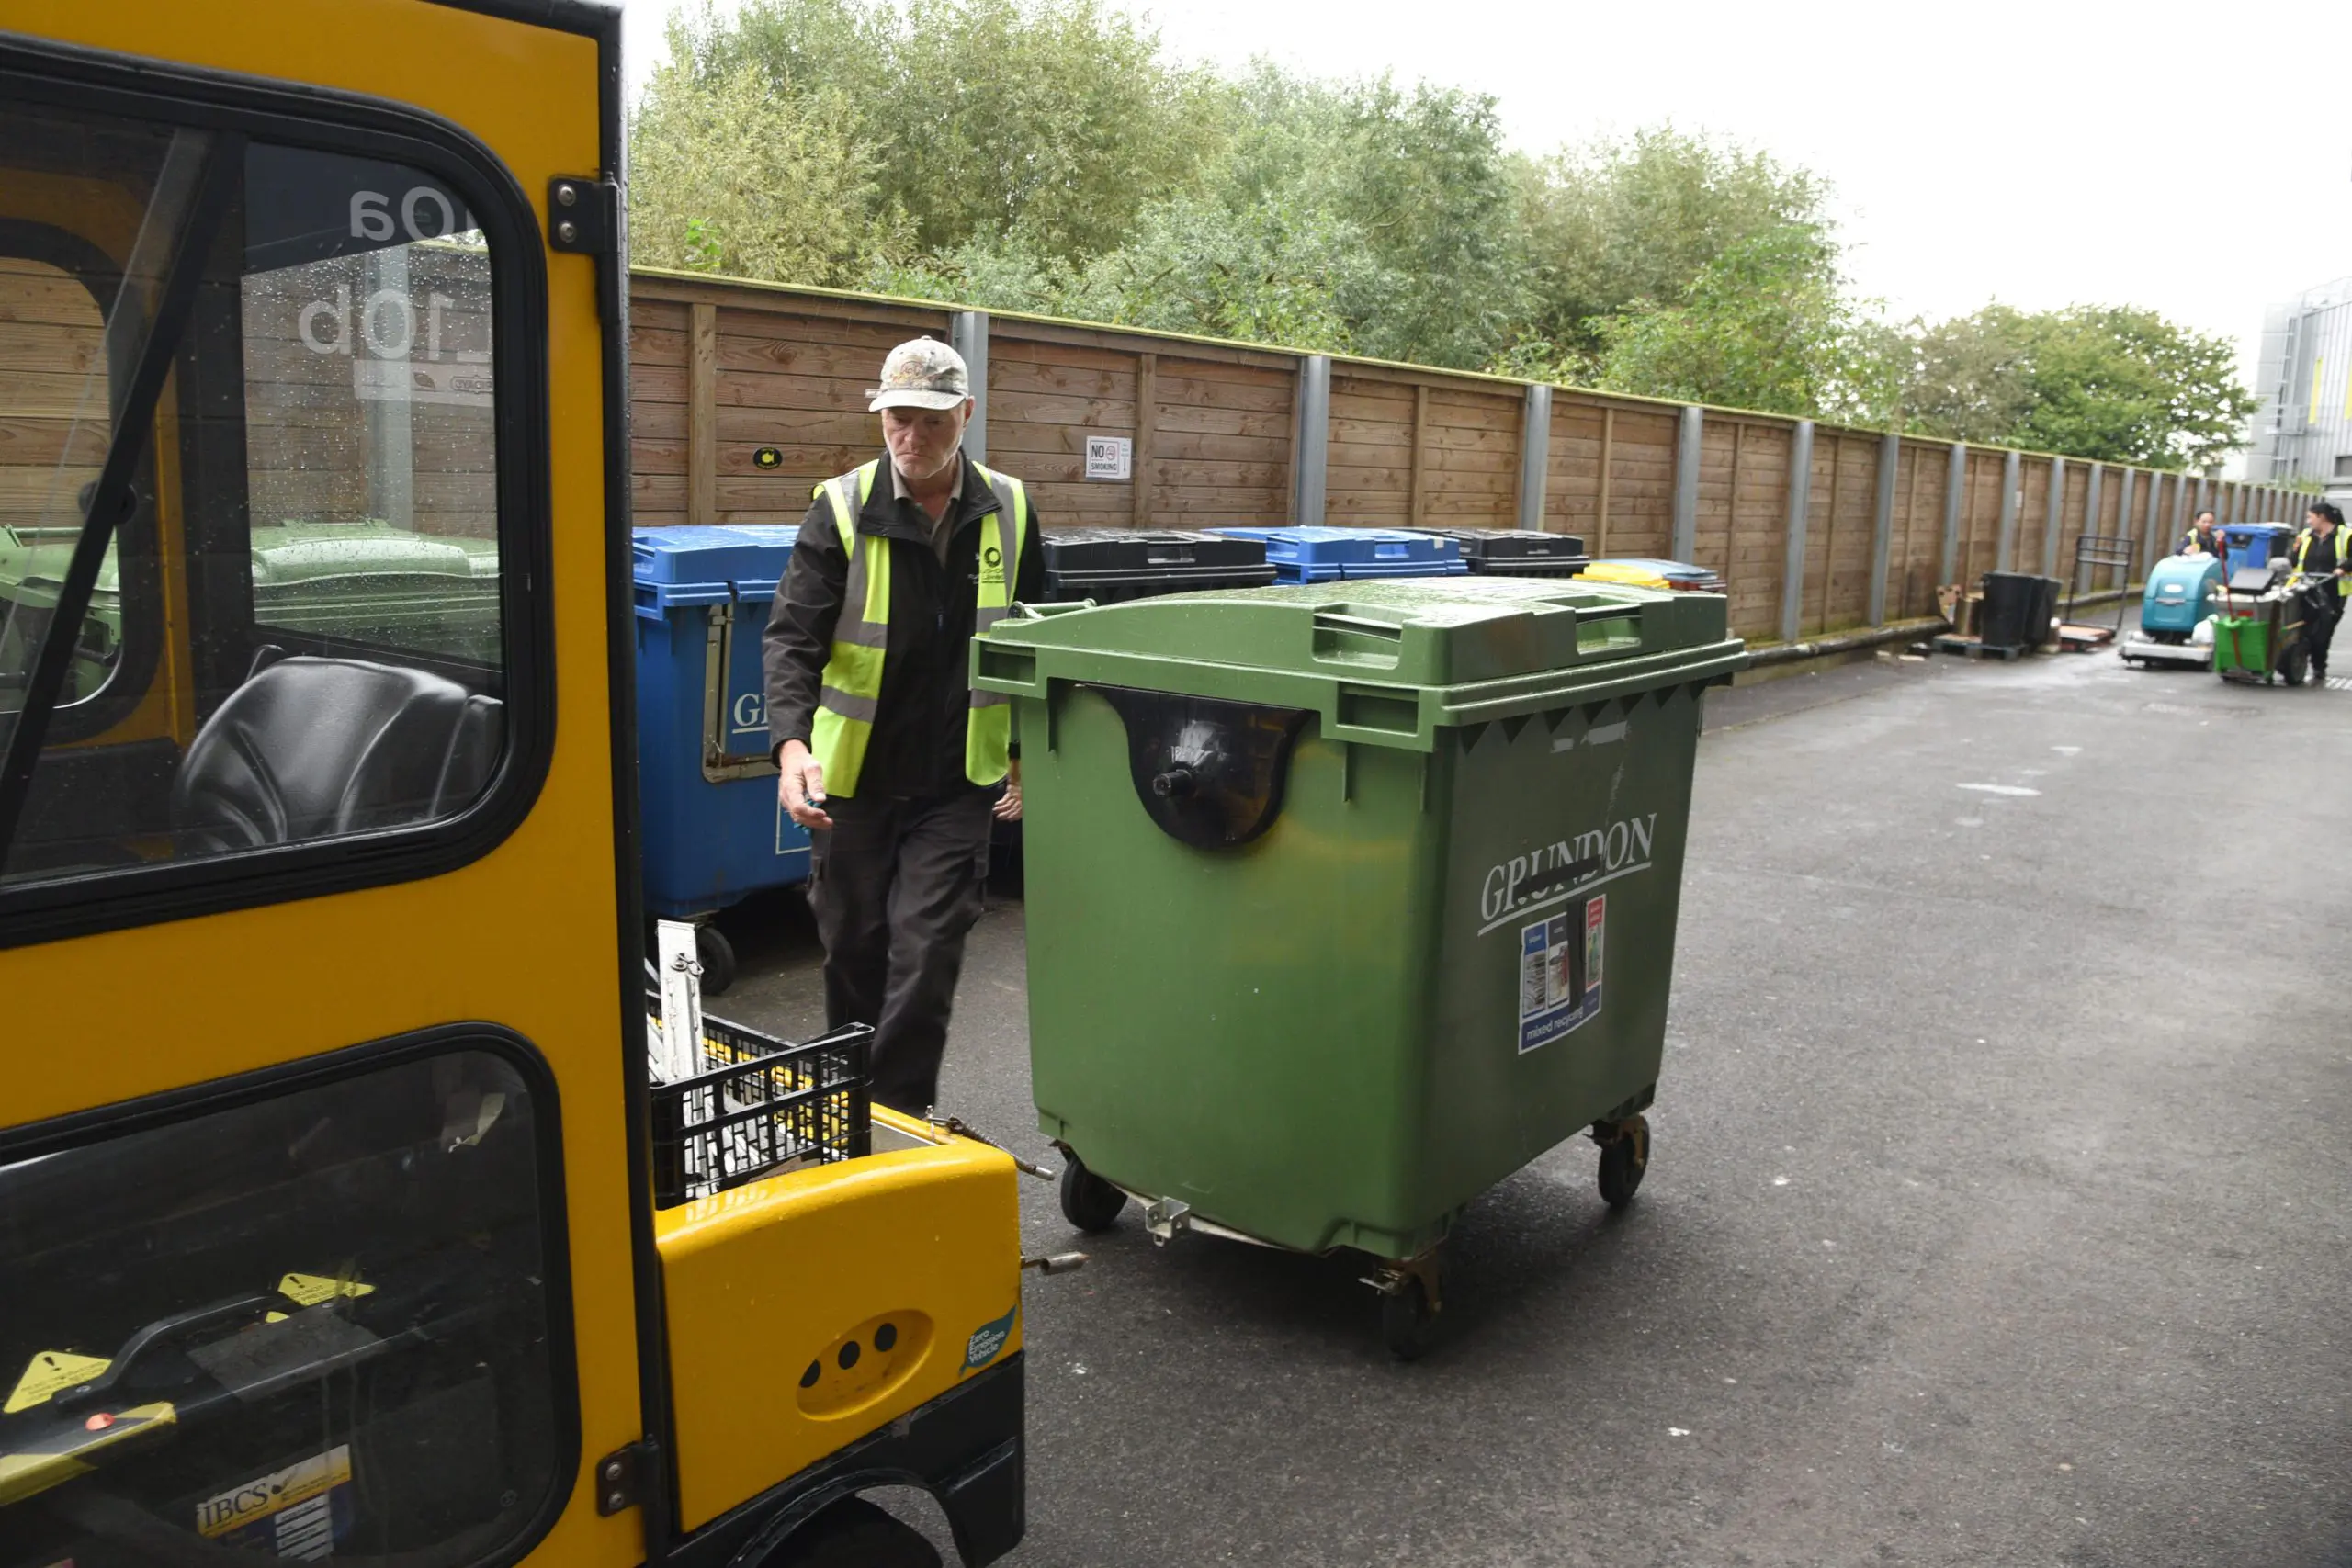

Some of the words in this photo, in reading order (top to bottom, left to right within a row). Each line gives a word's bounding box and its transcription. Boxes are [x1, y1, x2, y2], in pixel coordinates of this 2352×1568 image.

[1091, 445, 1104, 458] NO
[1091, 462, 1117, 471] SMOKING
[1526, 1020, 1554, 1041] mixed
[969, 1330, 990, 1343] Zero
[969, 1331, 1006, 1354] Emission
[969, 1344, 999, 1363] Vehicle
[202, 1482, 269, 1529] IBCS
